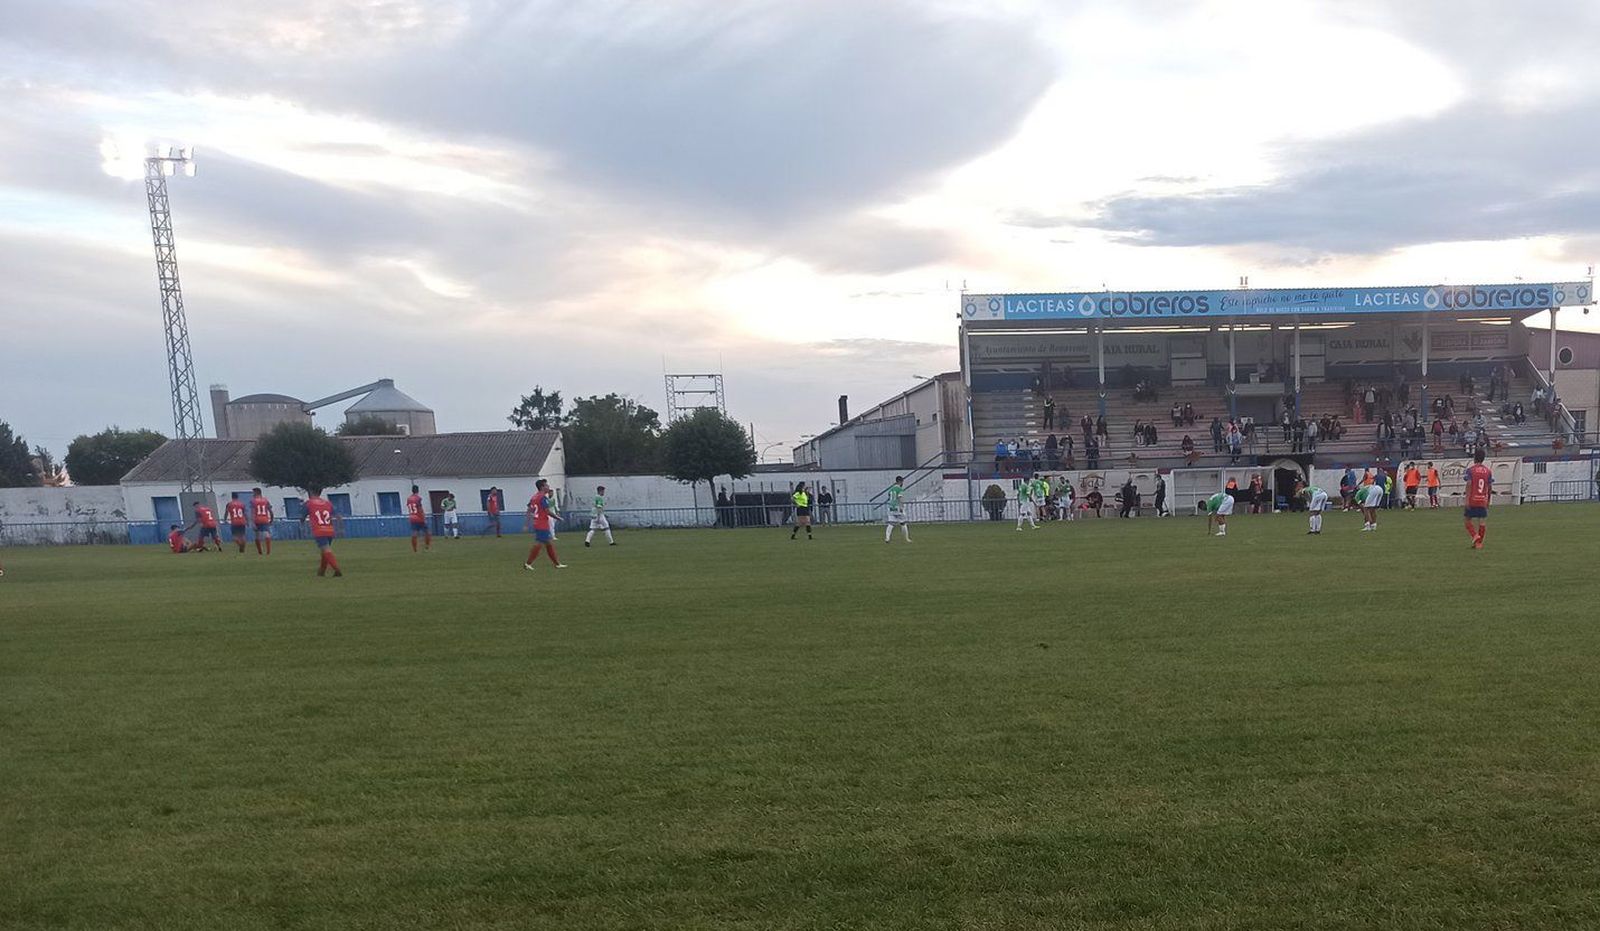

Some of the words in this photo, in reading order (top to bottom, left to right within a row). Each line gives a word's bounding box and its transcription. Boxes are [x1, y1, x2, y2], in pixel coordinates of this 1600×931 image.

[1007, 299, 1075, 313] LACTEAS
[1098, 293, 1210, 315] cobreros
[1354, 292, 1420, 306] LACTEAS
[1442, 286, 1550, 308] cobreros
[1103, 343, 1122, 355] AJA
[1478, 478, 1485, 493] 9
[232, 508, 243, 518] 10
[257, 504, 266, 515] 11
[314, 510, 330, 525] 12
